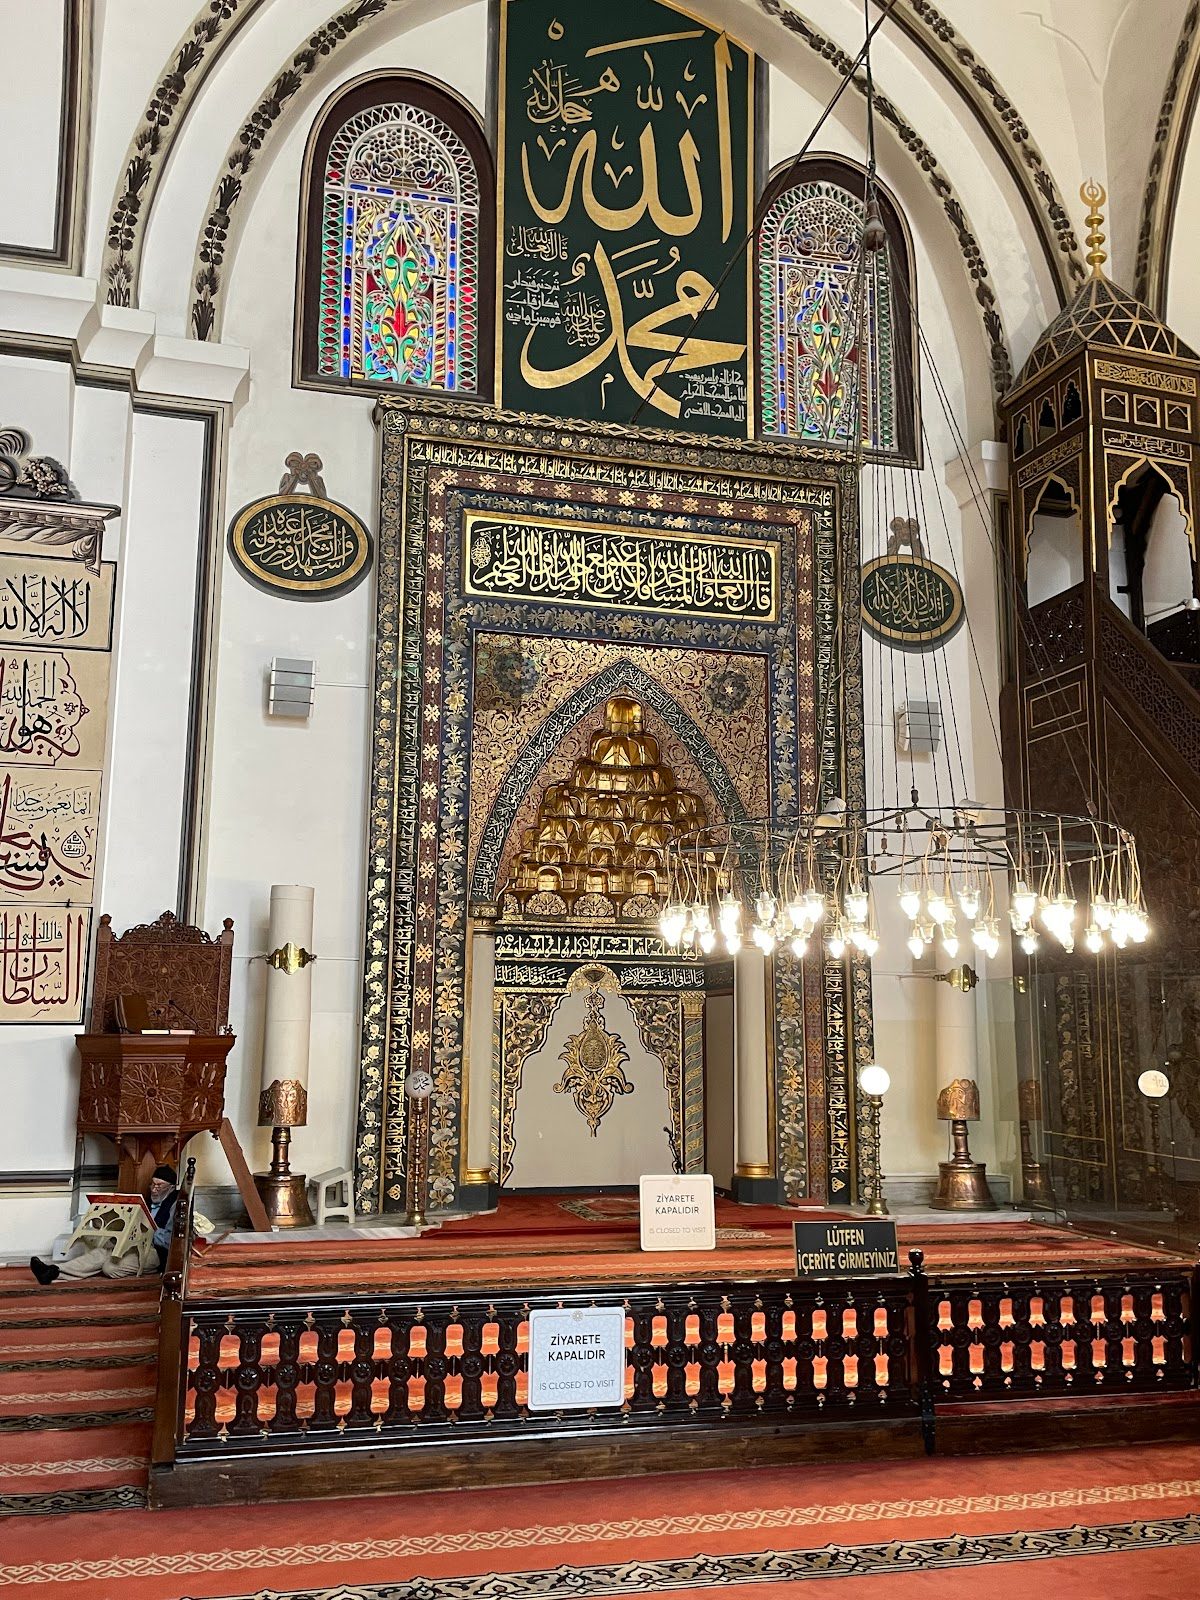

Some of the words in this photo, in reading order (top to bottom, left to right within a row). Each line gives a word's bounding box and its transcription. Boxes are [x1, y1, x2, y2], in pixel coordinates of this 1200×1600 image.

[656, 1193, 695, 1203] ZİYARETE
[655, 1206, 700, 1215] KAPALIDIR
[826, 1225, 865, 1246] LÜTFEN
[797, 1248, 836, 1275] İÇERİYE
[838, 1247, 897, 1269] GİRMEYİNİZ
[550, 1333, 601, 1346] ZİYARETE
[548, 1349, 606, 1362] KAPALIDIR
[539, 1382, 547, 1391] IS
[548, 1380, 582, 1390] CLOSED
[583, 1380, 595, 1388] TO
[596, 1379, 615, 1388] VISIT
